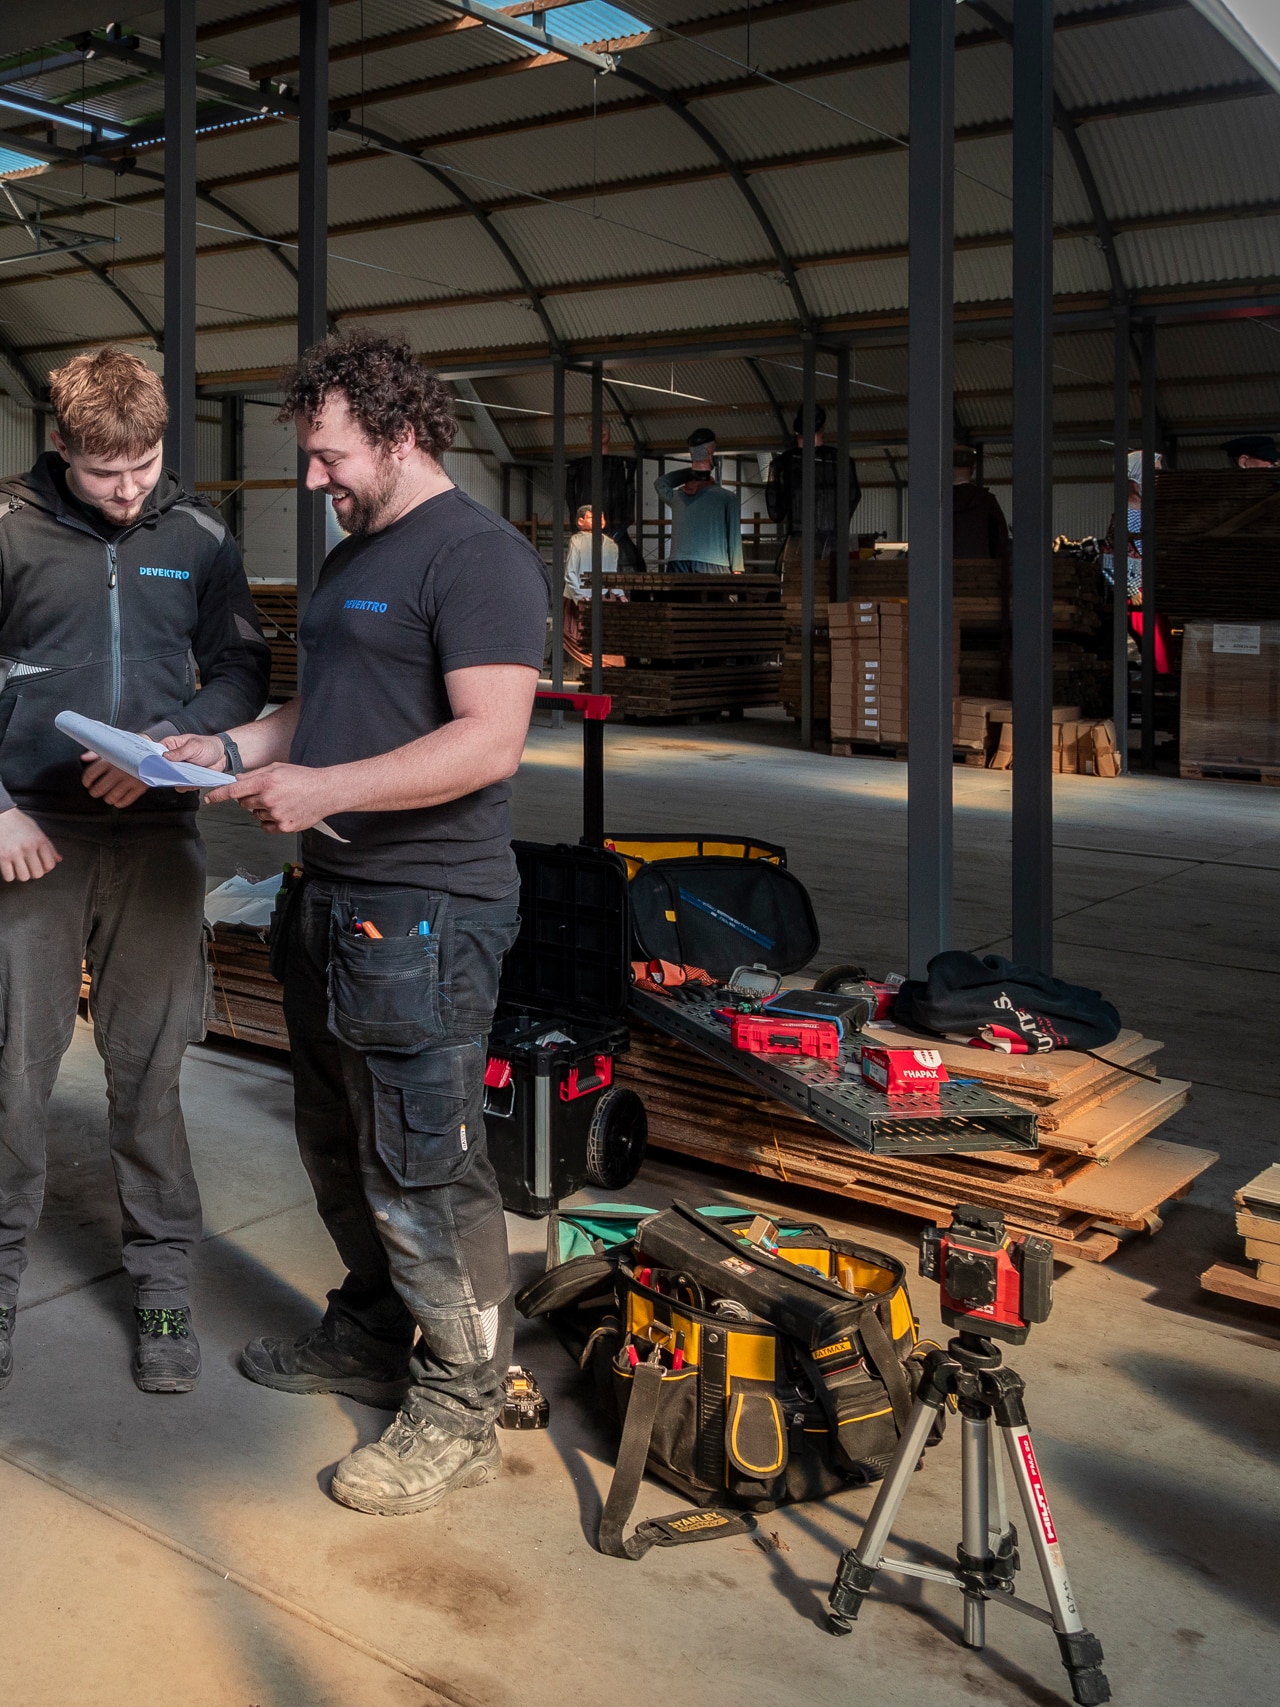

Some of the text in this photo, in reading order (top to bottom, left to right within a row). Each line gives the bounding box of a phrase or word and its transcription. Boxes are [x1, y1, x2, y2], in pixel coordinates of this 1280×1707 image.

[139, 566, 190, 580] DEVEKTRO
[343, 599, 388, 614] DEVEKTRO
[1028, 1453, 1038, 1476] PMA
[1034, 1483, 1055, 1540] HILTI
